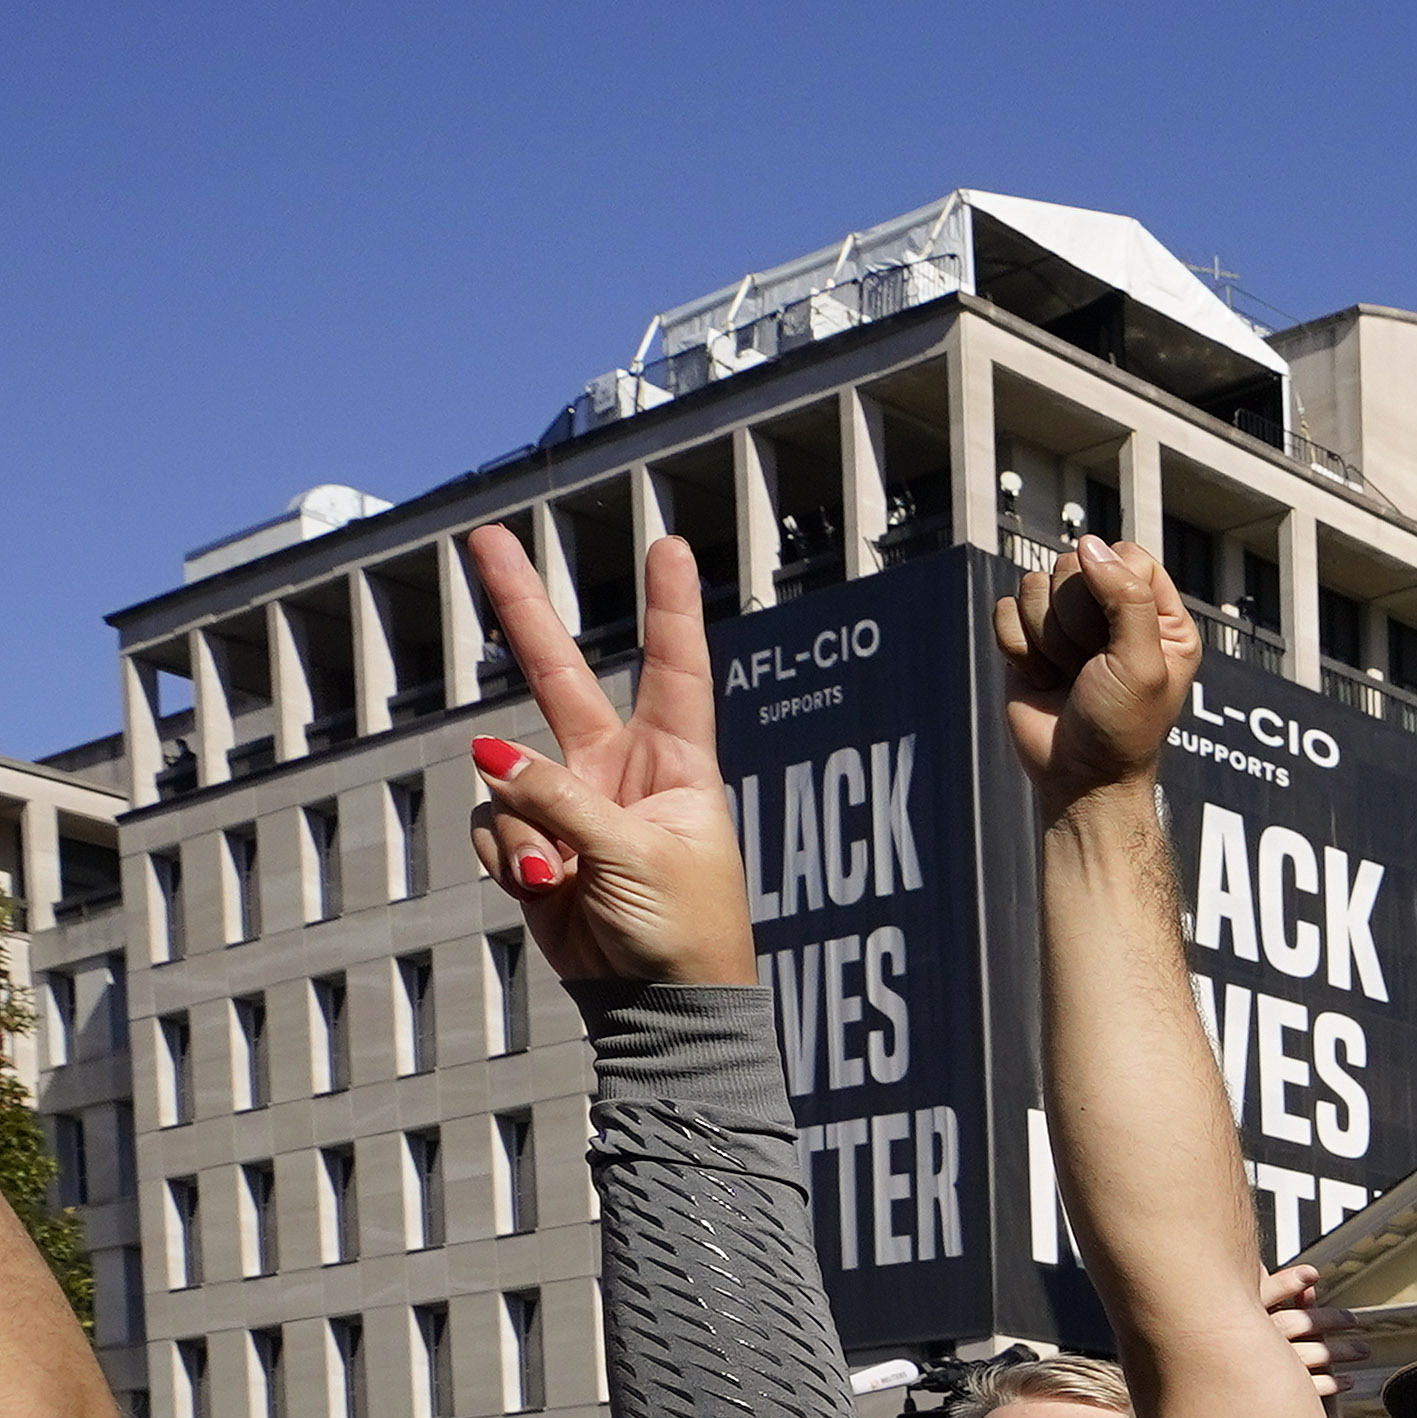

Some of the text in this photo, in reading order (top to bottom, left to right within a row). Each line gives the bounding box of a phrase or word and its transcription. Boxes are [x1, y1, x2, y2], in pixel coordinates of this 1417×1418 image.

[725, 619, 880, 696] AFL-CIO
[759, 685, 843, 725] SUPPORTS
[1166, 726, 1290, 788] SUPPORTS
[1192, 681, 1340, 769] L-CIO
[725, 733, 923, 924] LACK
[1190, 802, 1389, 1003] ACK
[757, 926, 910, 1097] VES
[1196, 973, 1371, 1159] VES
